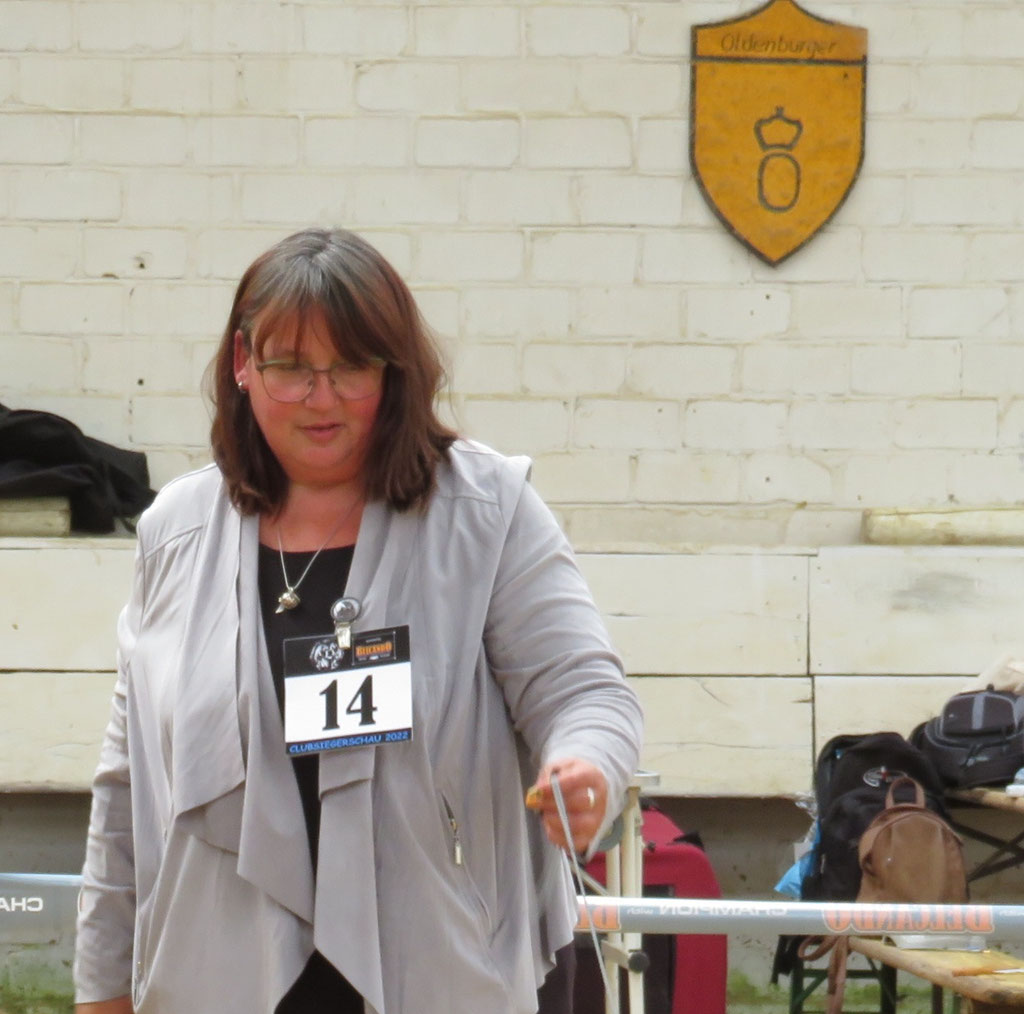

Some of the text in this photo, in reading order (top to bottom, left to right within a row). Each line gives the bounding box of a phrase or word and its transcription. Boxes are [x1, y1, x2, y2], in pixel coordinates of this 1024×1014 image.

[720, 32, 838, 58] Oldenburger
[319, 674, 378, 731] 14
[289, 731, 409, 753] CLUBSIEGERSCHAU 2022
